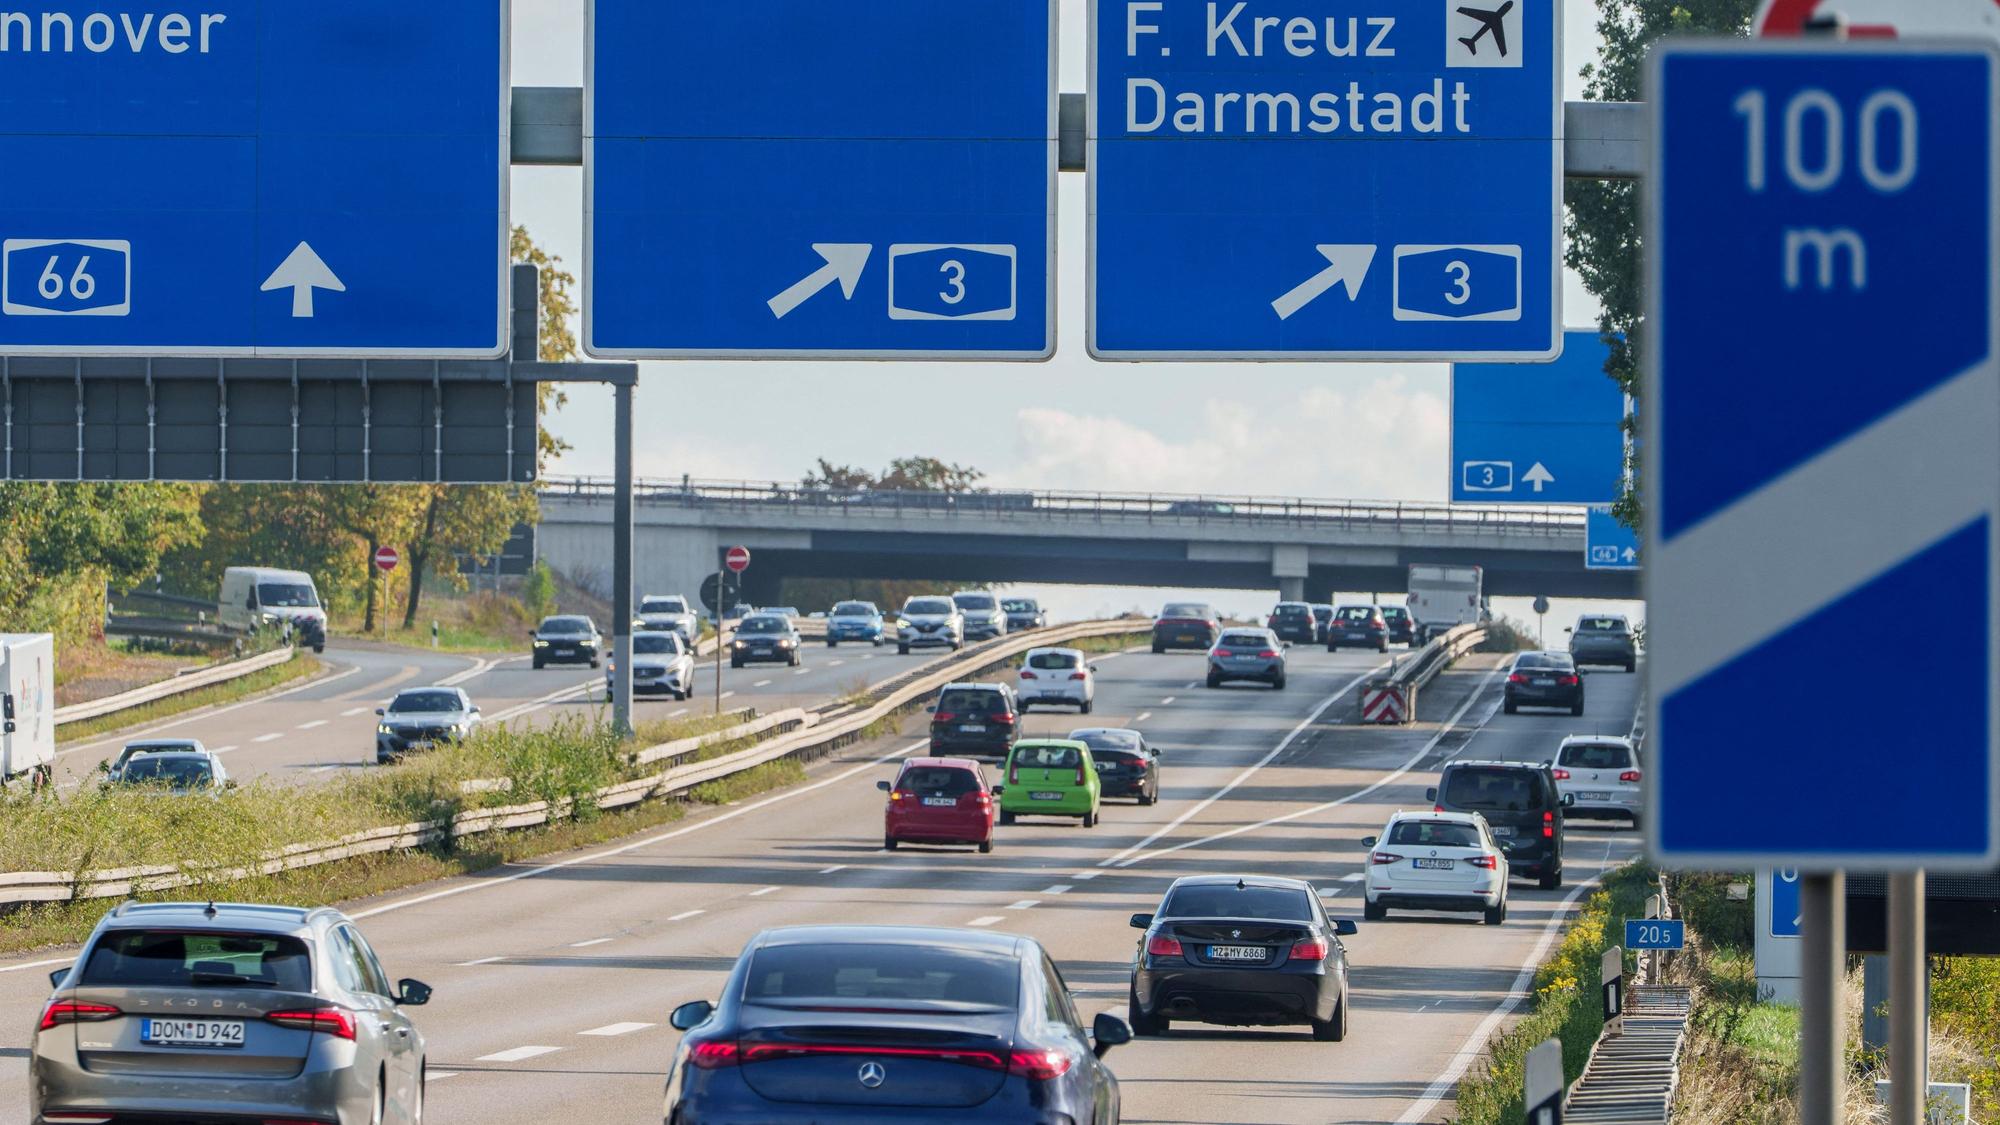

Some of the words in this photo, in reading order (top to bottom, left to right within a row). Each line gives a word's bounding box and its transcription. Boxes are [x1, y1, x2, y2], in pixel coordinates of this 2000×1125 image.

[0, 12, 227, 54] nnover
[1127, 1, 1171, 57] F.
[1206, 1, 1396, 57] Kreuz
[1126, 77, 1471, 134] Darmstadt
[1734, 89, 1918, 192] 100
[37, 255, 96, 301] 66
[1784, 228, 1866, 288] m
[939, 259, 966, 306] 3
[1444, 260, 1471, 306] 3
[1482, 466, 1494, 486] 3
[1213, 947, 1224, 957] MZ
[1231, 947, 1242, 958] MY
[1243, 948, 1265, 958] 6868
[1638, 925, 1671, 944] 20.5
[152, 1022, 185, 1038] DON
[196, 1023, 206, 1039] D
[210, 1023, 242, 1040] 942
